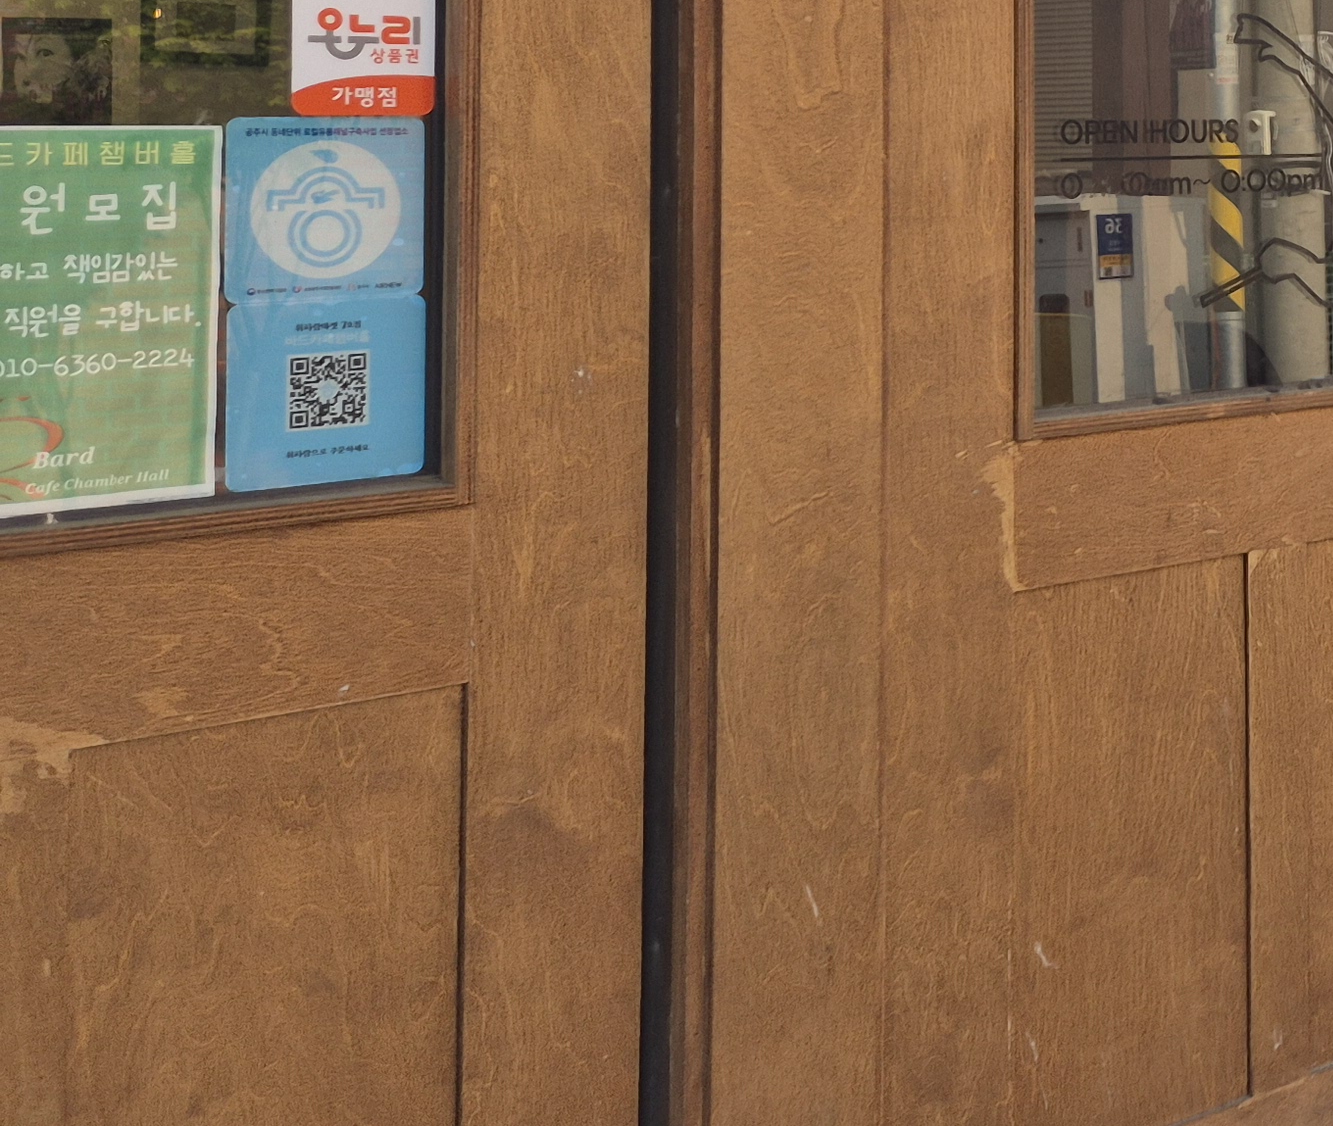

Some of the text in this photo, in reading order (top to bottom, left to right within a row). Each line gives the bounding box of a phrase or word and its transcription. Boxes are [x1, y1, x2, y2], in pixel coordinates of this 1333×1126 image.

[307, 7, 421, 60] 온누리
[370, 47, 420, 64] 상품권
[331, 86, 399, 109] 가맹점
[1060, 118, 1240, 146] OPEN HOURS
[63, 251, 179, 284] 책임감있는
[4, 300, 202, 338] 직원을 구합니다.
[0, 347, 195, 378] 10-6360-2224
[32, 445, 97, 470] Bard
[24, 467, 171, 496] Cafe Chamber Hall
